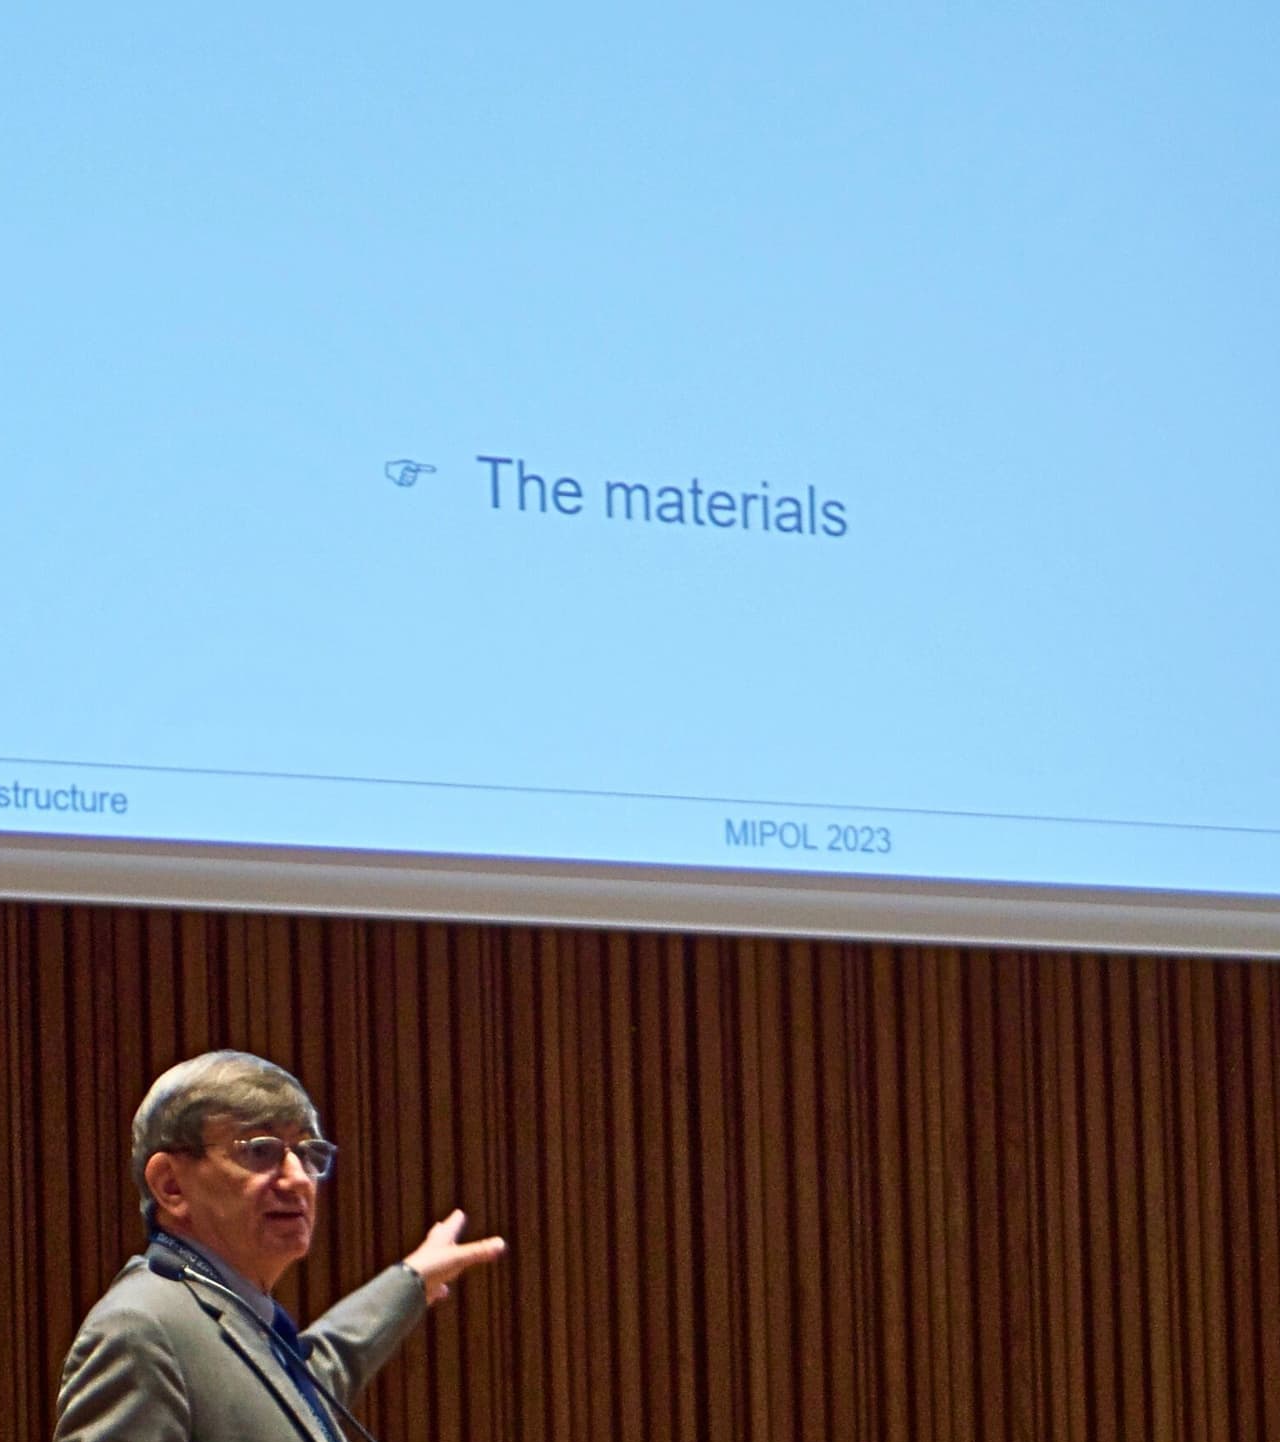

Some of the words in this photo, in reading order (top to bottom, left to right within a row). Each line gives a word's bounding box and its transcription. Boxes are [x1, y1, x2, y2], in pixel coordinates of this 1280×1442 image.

[476, 455, 583, 515] The
[605, 477, 849, 538] materials
[724, 818, 819, 850] MIPOL
[826, 824, 892, 854] 2023
